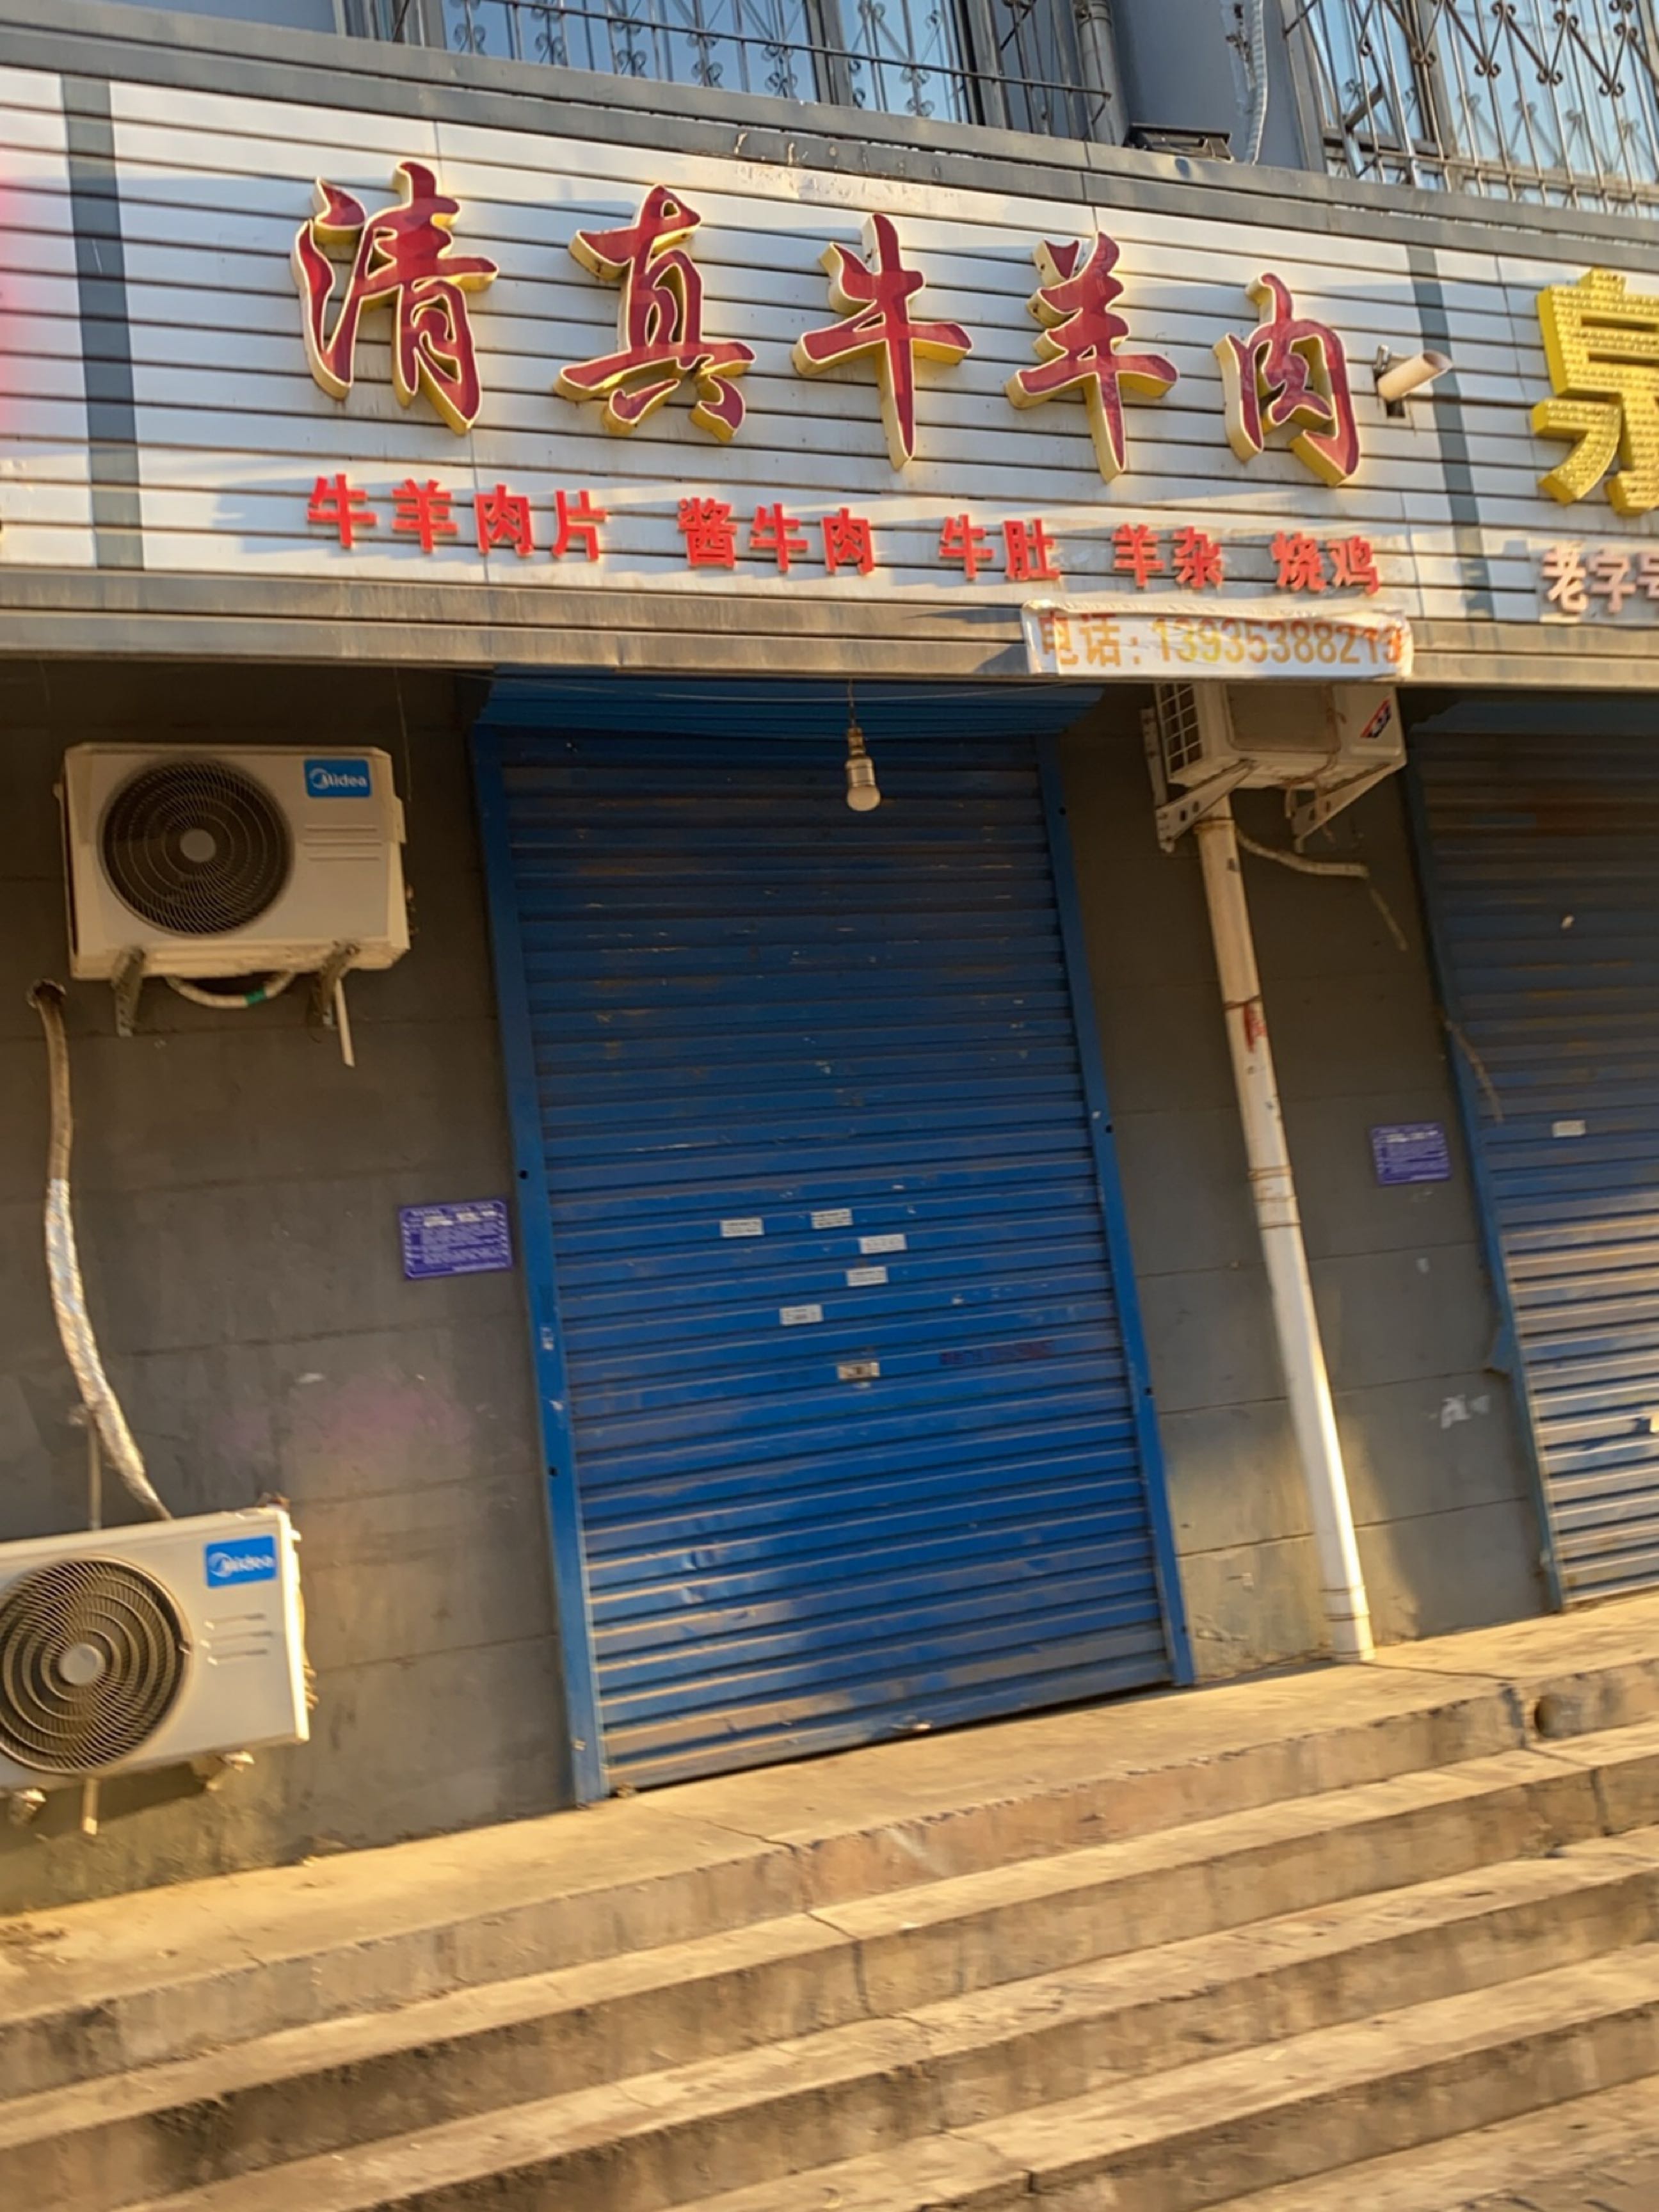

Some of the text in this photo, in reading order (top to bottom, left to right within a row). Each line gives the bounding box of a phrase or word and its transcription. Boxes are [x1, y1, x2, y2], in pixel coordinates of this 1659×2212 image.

[291, 160, 1359, 487] 清真牛羊肉
[307, 474, 1379, 596] 牛羊肉片 酱牛肉 牛肚 羊杂 烧鸡
[317, 771, 368, 789] Midea
